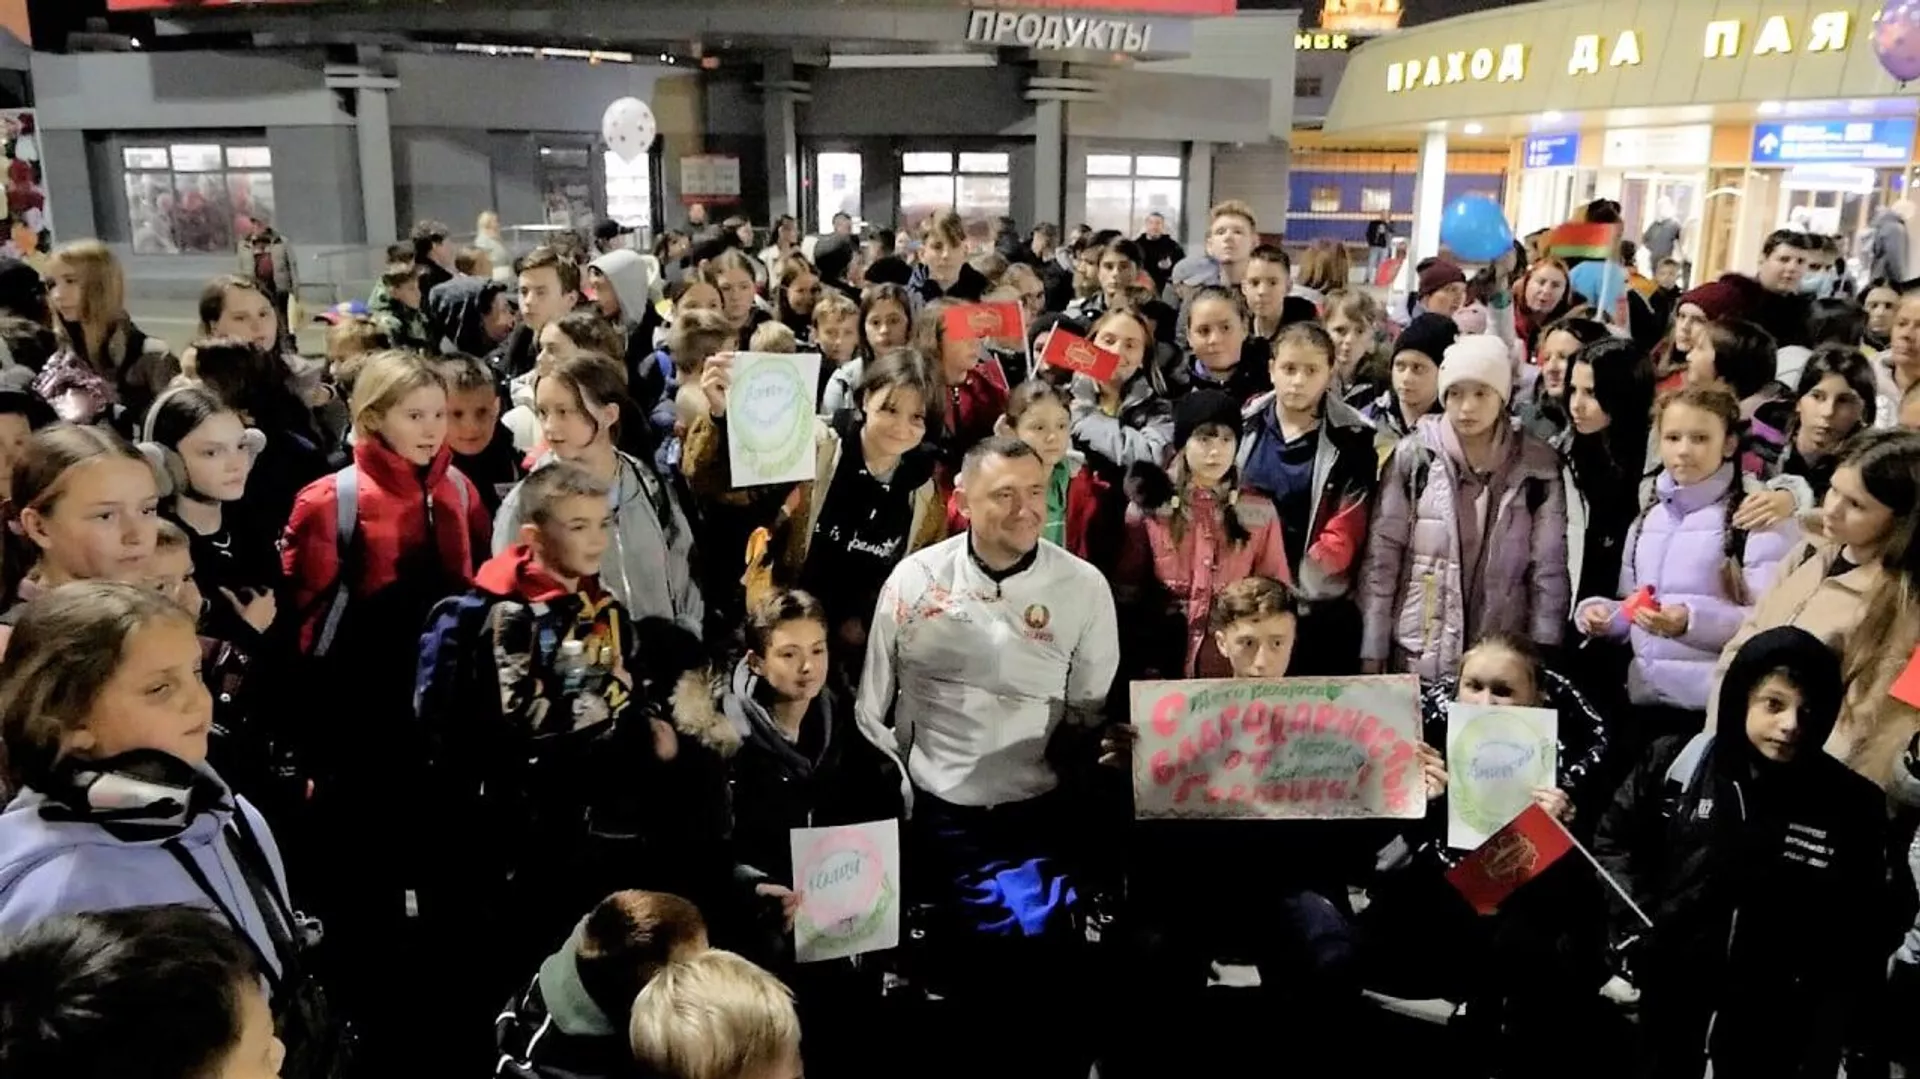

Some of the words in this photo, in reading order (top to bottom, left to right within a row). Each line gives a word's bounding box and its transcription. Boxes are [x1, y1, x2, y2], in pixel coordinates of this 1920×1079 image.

[966, 10, 1152, 52] ПРОДУКТЫ
[1387, 43, 1524, 92] ПРАХОД
[1568, 30, 1641, 75] ДА
[1704, 10, 1880, 58] ПАЯ
[1151, 691, 1187, 737] С
